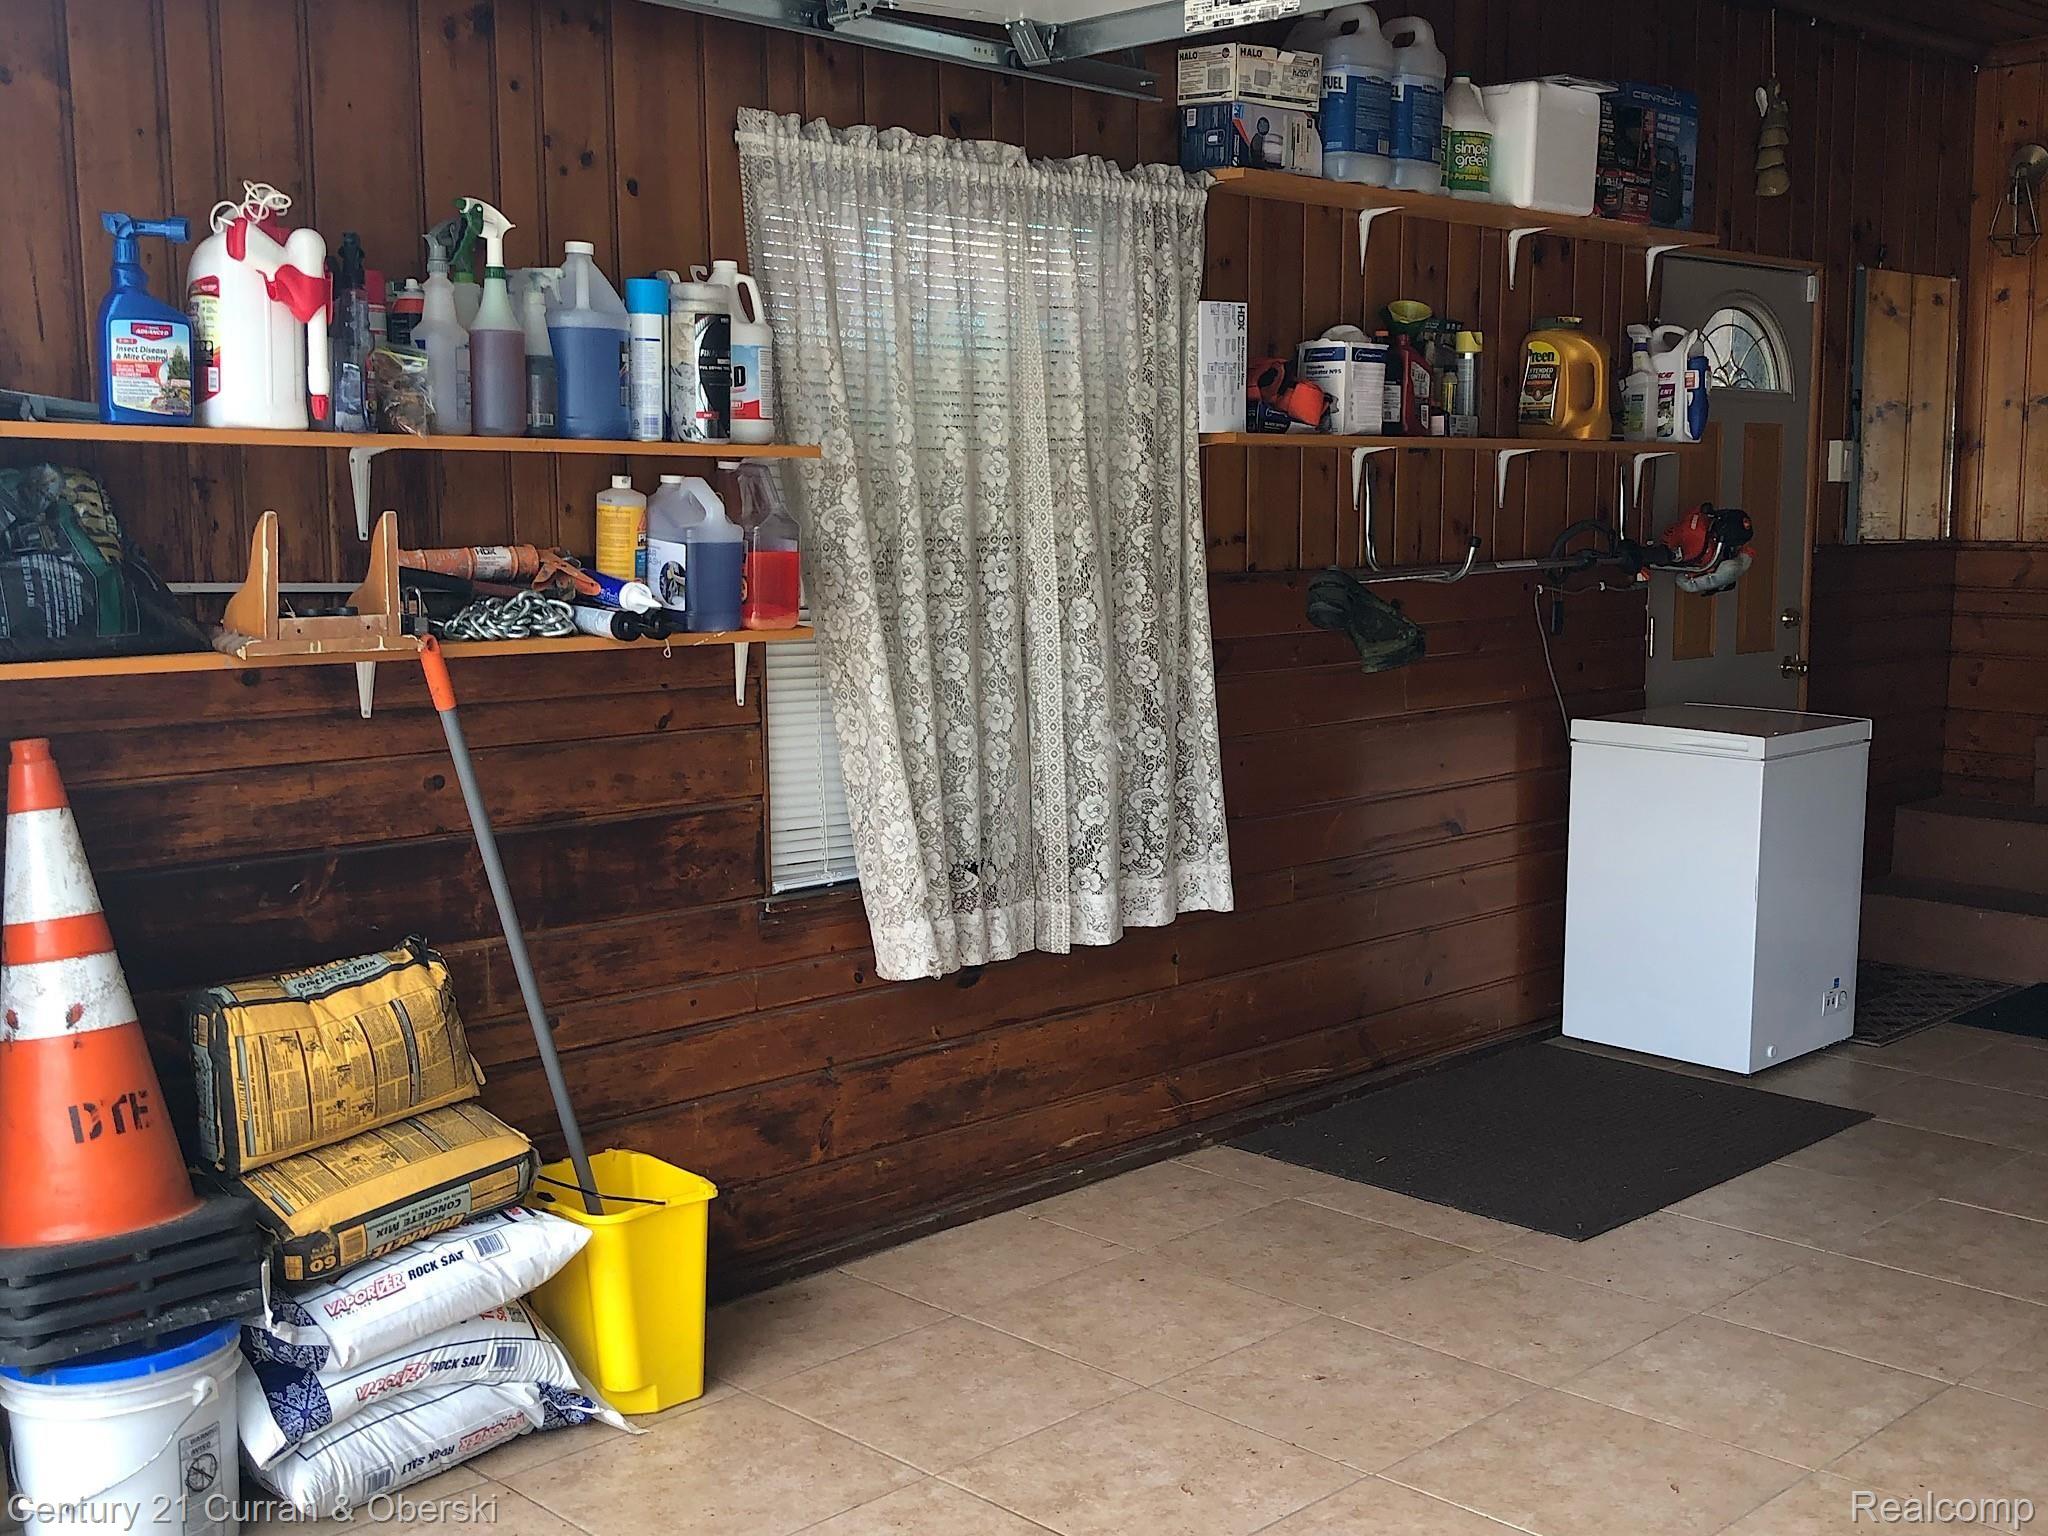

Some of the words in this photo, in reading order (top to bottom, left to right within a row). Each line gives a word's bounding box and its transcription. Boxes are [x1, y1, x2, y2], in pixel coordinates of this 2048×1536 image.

[1179, 52, 1198, 61] HALO
[1240, 48, 1263, 58] HALO
[1322, 76, 1344, 90] FUEL
[1454, 140, 1489, 158] simple
[1455, 155, 1488, 169] green
[1237, 305, 1246, 331] HDX
[115, 345, 138, 353] Insect
[140, 346, 168, 354] Disease
[475, 548, 497, 556] HDX
[352, 960, 377, 974] MIX
[68, 1090, 150, 1144] DTE
[403, 1198, 462, 1228] CONCRETE
[371, 1213, 464, 1260] QUIKRETE
[375, 1221, 400, 1239] MIX
[309, 1255, 337, 1273] 60
[324, 1272, 406, 1317] VAPORIZER
[408, 1259, 439, 1281] ROCK
[441, 1250, 465, 1267] SALT
[430, 1358, 459, 1374] ROCK
[461, 1354, 488, 1370] SALT
[400, 1456, 426, 1476] SALT
